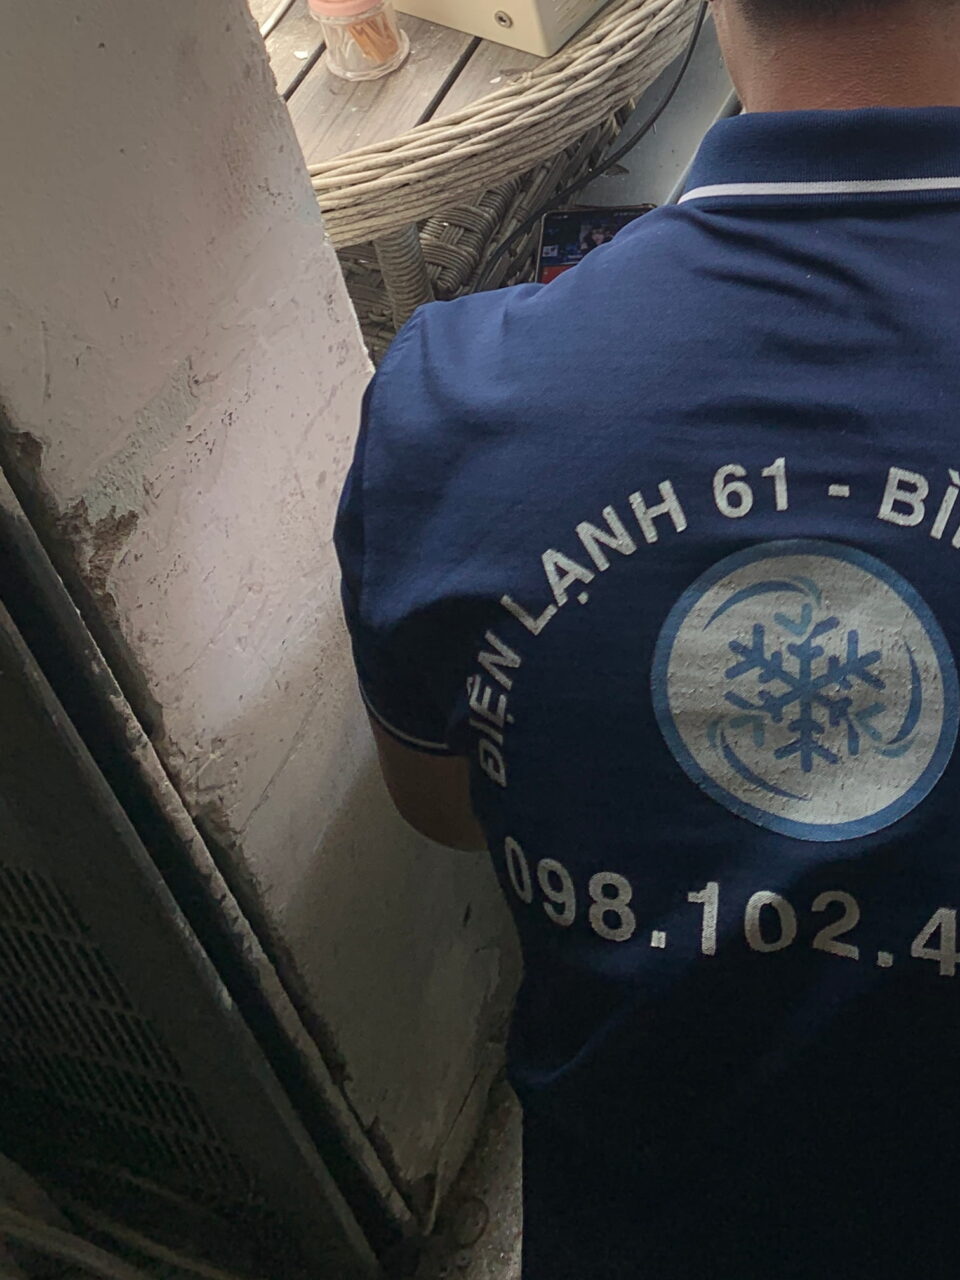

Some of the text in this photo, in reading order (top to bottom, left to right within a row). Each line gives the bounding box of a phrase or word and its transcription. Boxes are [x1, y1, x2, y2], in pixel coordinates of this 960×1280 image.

[466, 629, 522, 788] ĐIỆN
[501, 480, 687, 636] LẠNH
[713, 457, 788, 518] 61
[828, 483, 850, 498] -
